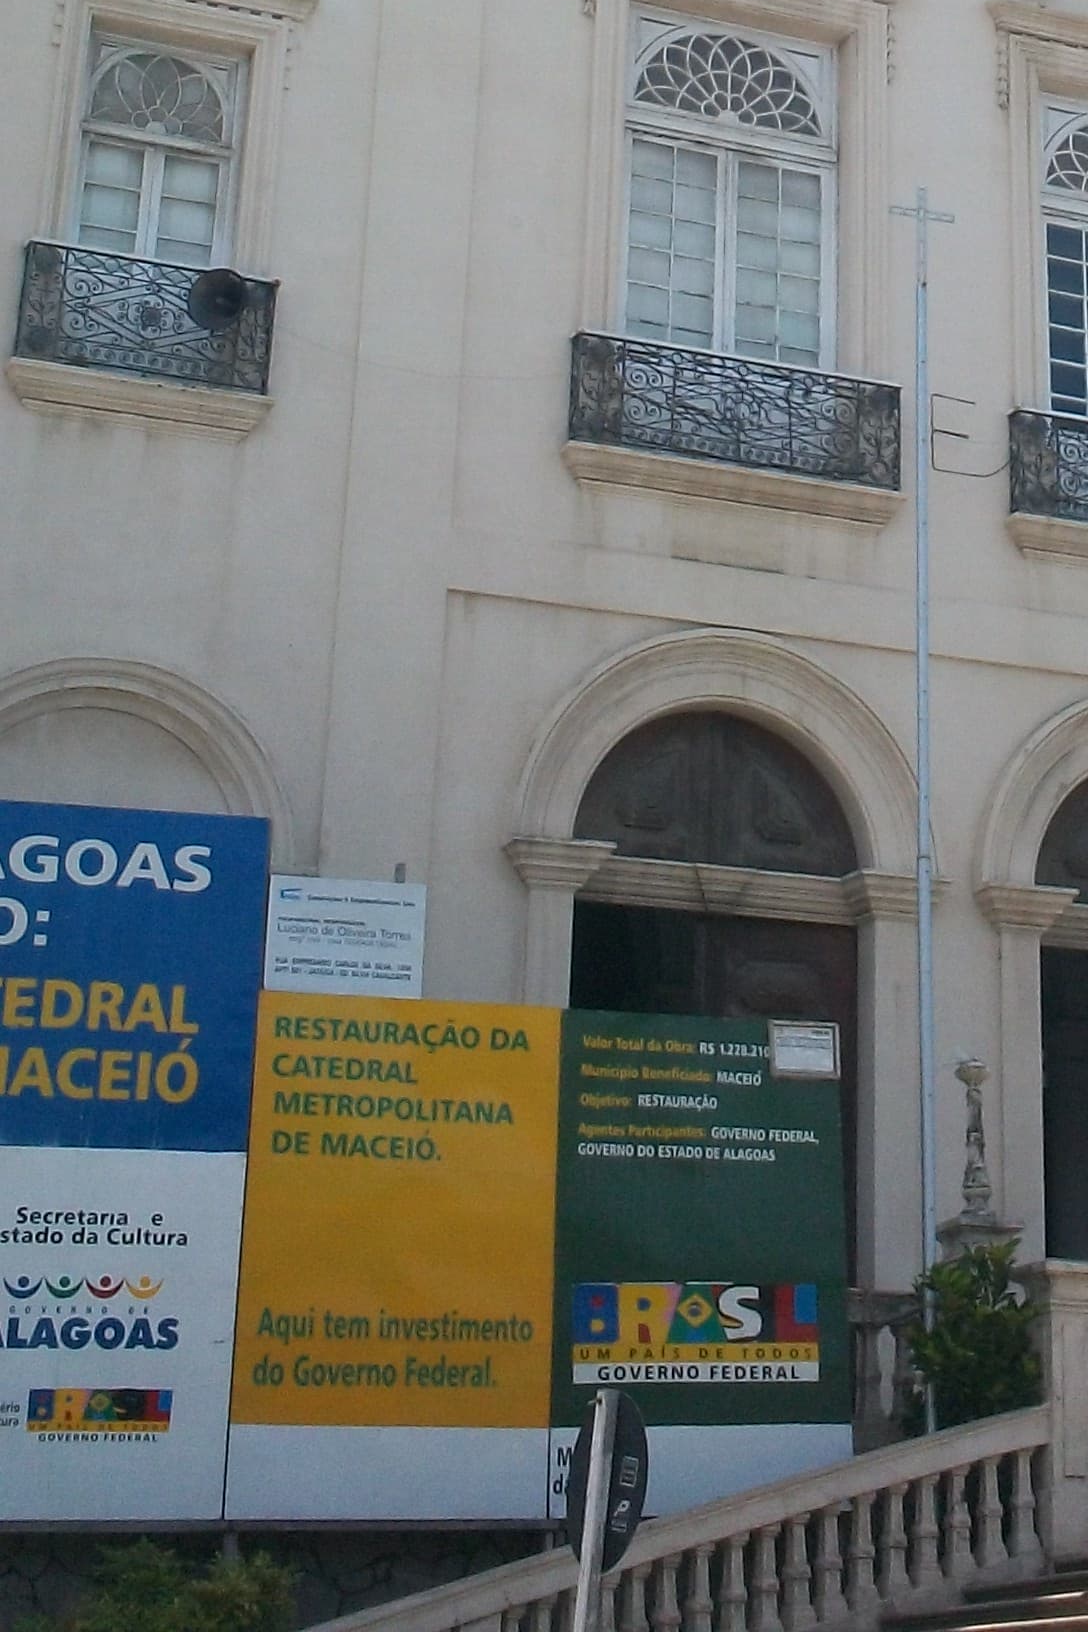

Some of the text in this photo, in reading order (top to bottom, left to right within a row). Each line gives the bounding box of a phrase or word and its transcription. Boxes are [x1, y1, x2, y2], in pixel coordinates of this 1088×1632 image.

[0, 834, 212, 893] GOAS
[277, 924, 317, 935] Luciano
[321, 927, 334, 936] de
[337, 927, 377, 938] Oliveira
[0, 977, 199, 1034] EDRAL
[274, 1017, 530, 1054] RESTAURAÇÃO DA
[583, 1035, 612, 1050] Valor
[616, 1037, 644, 1051] Total
[647, 1039, 661, 1052] da
[0, 1038, 198, 1104] ACEIÓ
[272, 1053, 417, 1084] CATEDRAL
[716, 1070, 762, 1086] MACEIÓ
[273, 1091, 514, 1125] METROPOLITANA
[637, 1093, 718, 1112] RESTAURAÇÃO
[271, 1129, 441, 1161] DE MACEIÓ.
[711, 1126, 765, 1142] GOVERNO
[768, 1129, 819, 1144] FEDERAL,
[578, 1142, 776, 1162] GOVERNO DO ESTADO DE ALAGOAS
[71, 1228, 98, 1245] da
[107, 1228, 188, 1246] Cultura
[9, 1305, 108, 1314] GOVERNO
[0, 1317, 180, 1350] LAGOAS
[258, 1308, 533, 1345] Aqui tem investimento
[579, 1346, 812, 1360] UM PAÍS DE TODOS
[252, 1355, 284, 1386] do
[293, 1355, 397, 1386] Governo
[597, 1365, 800, 1381] GOVERNO FEDERAL
[38, 1433, 158, 1443] GOVERNO FEDERAL
